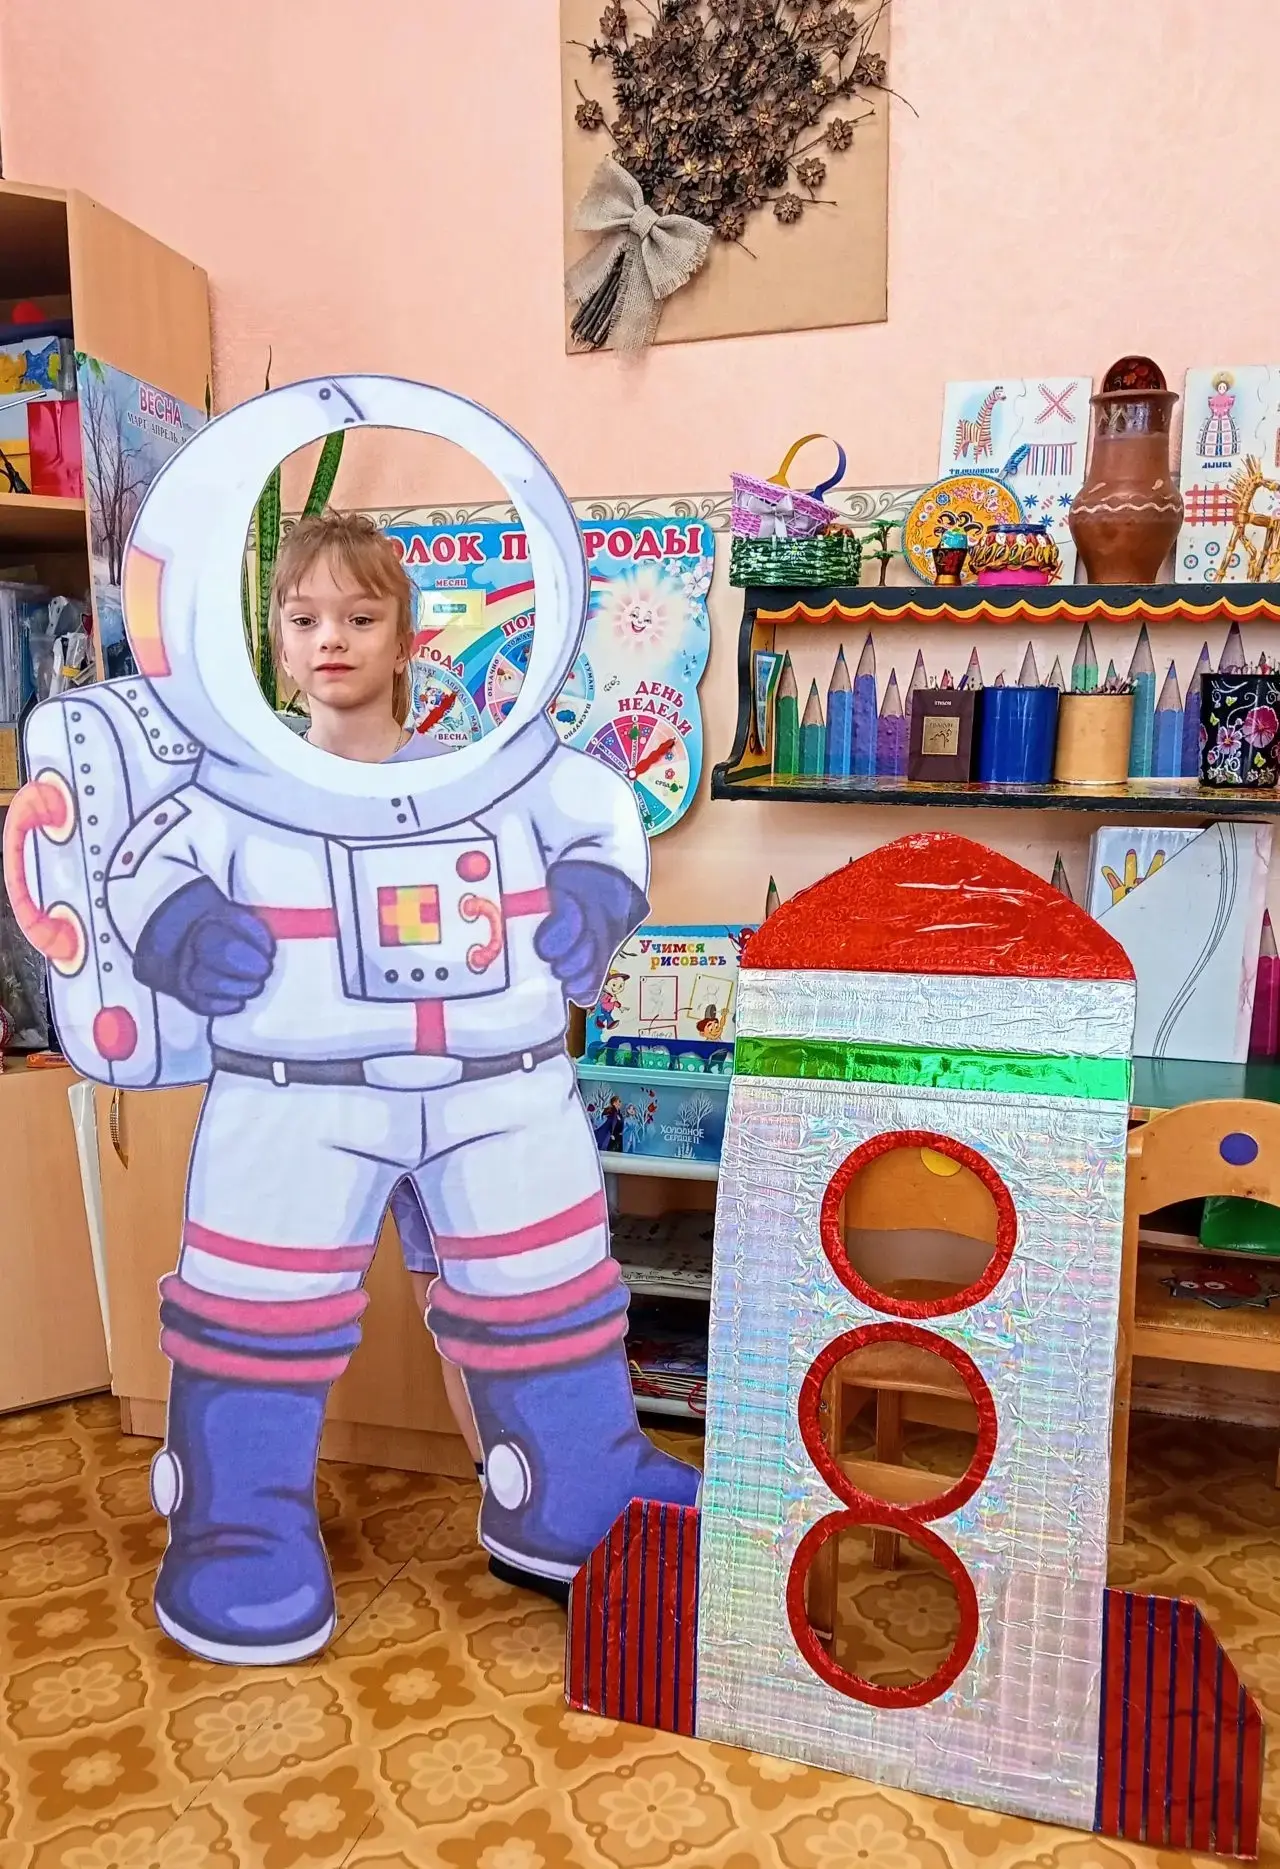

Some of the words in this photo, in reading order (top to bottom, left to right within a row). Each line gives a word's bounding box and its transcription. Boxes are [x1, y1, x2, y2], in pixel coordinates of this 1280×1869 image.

[139, 385, 183, 429] ВЕСНА
[435, 578, 468, 588] МЕСЯЦ
[419, 645, 464, 678] ГОДА
[584, 661, 594, 690] ТУМАН
[487, 658, 499, 697] ОБЛАЧНО
[635, 680, 685, 708] ДЕНЬ
[563, 702, 592, 741] ПАСМУРНО
[618, 697, 693, 736] НЕДЕЛИ
[437, 732, 468, 741] ВЕСНА
[639, 939, 706, 954] Учимся
[650, 955, 727, 971] рисовать
[660, 1124, 705, 1139] ХОЛОДНОЕ
